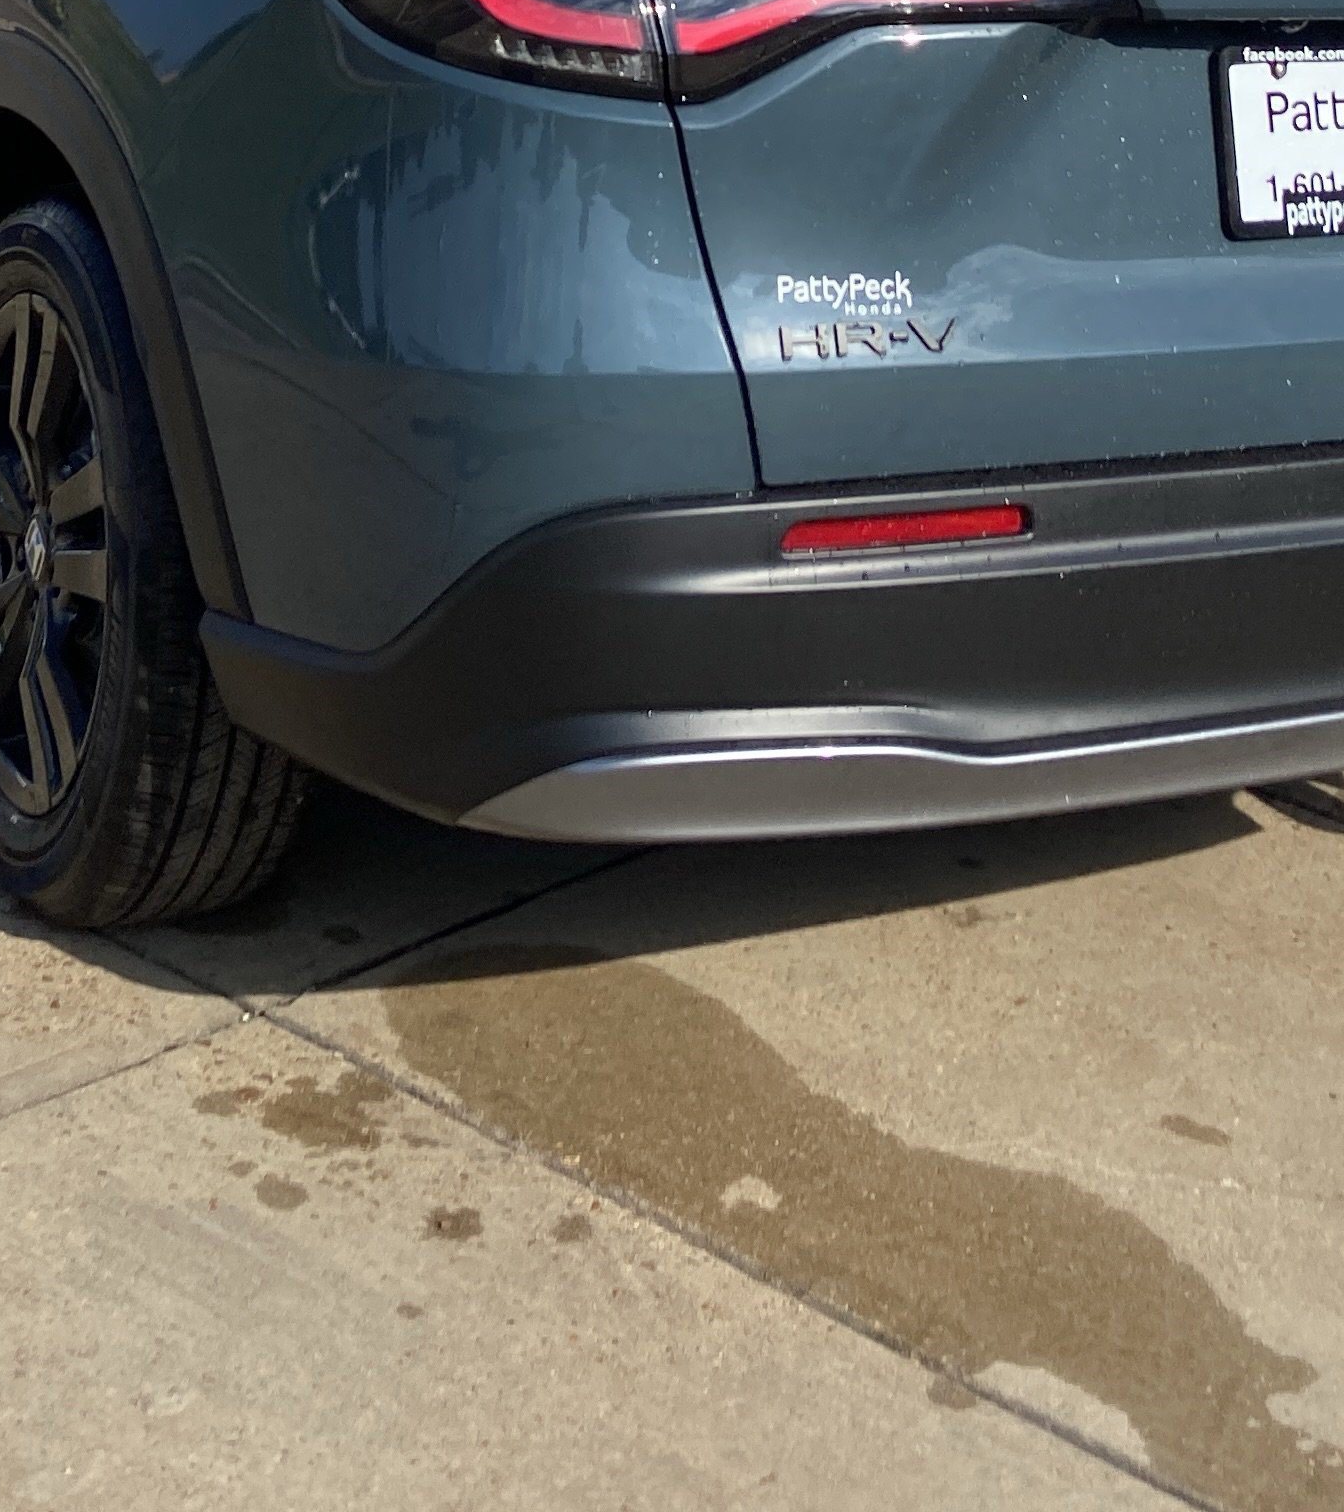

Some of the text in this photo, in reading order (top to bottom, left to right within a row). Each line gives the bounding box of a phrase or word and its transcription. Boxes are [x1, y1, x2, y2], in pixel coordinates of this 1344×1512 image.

[776, 270, 913, 310] PattyPeck
[844, 300, 903, 317] Honda
[777, 317, 956, 362] HR-V
